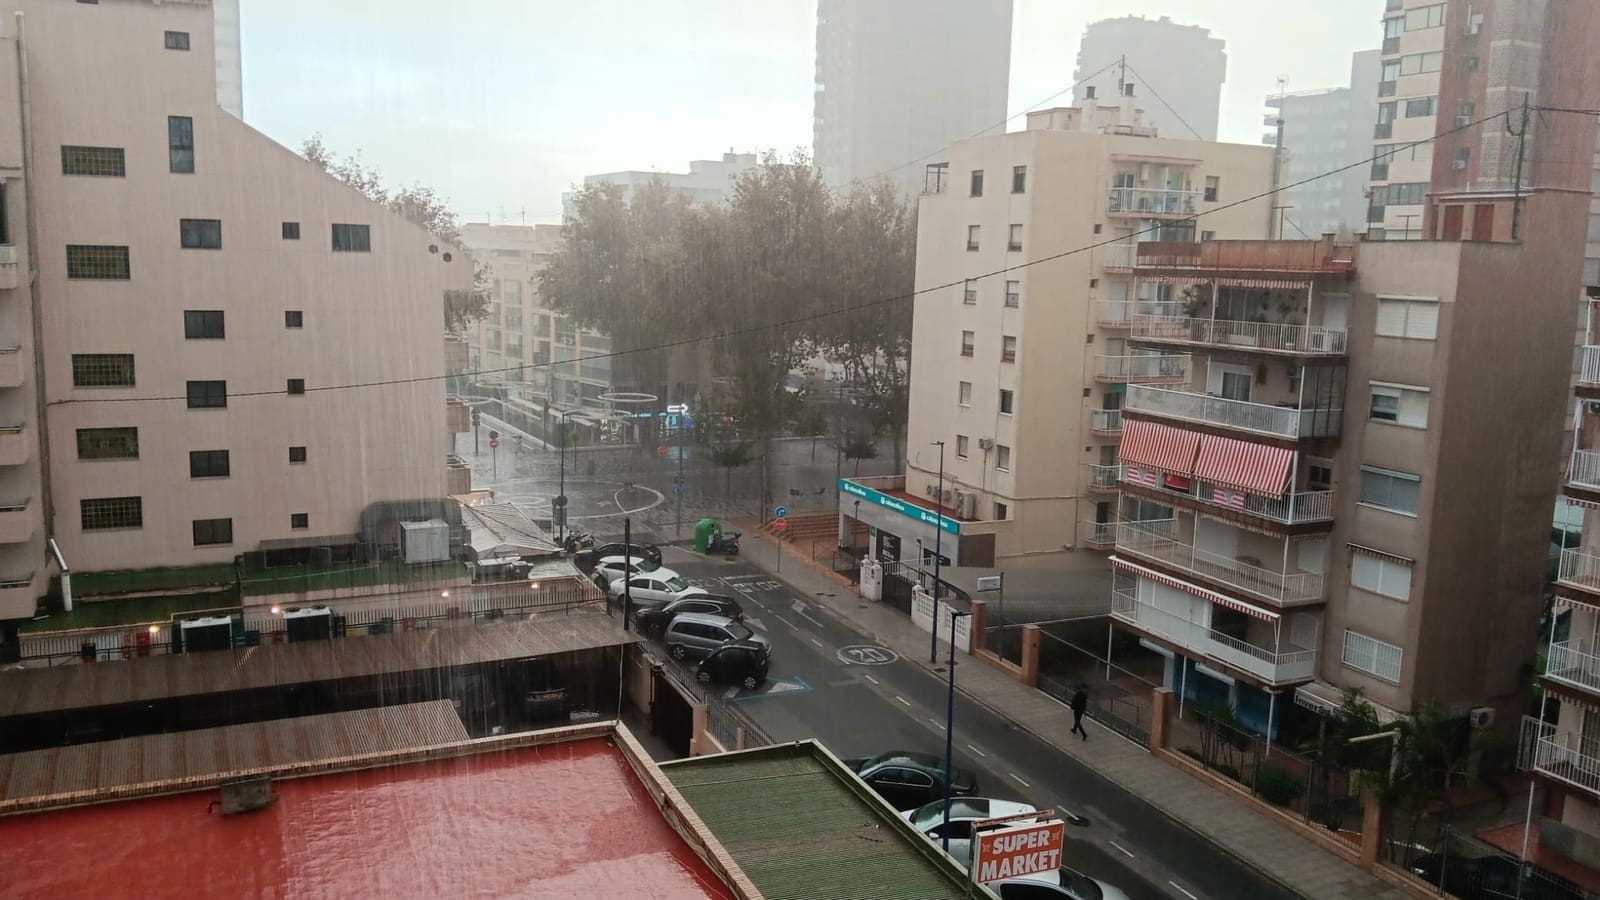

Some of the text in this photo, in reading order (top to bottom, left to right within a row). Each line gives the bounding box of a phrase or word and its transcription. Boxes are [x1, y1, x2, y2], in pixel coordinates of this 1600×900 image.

[733, 581, 782, 593] STOP
[992, 830, 1050, 855] SUPER
[980, 849, 1060, 882] MARKET
